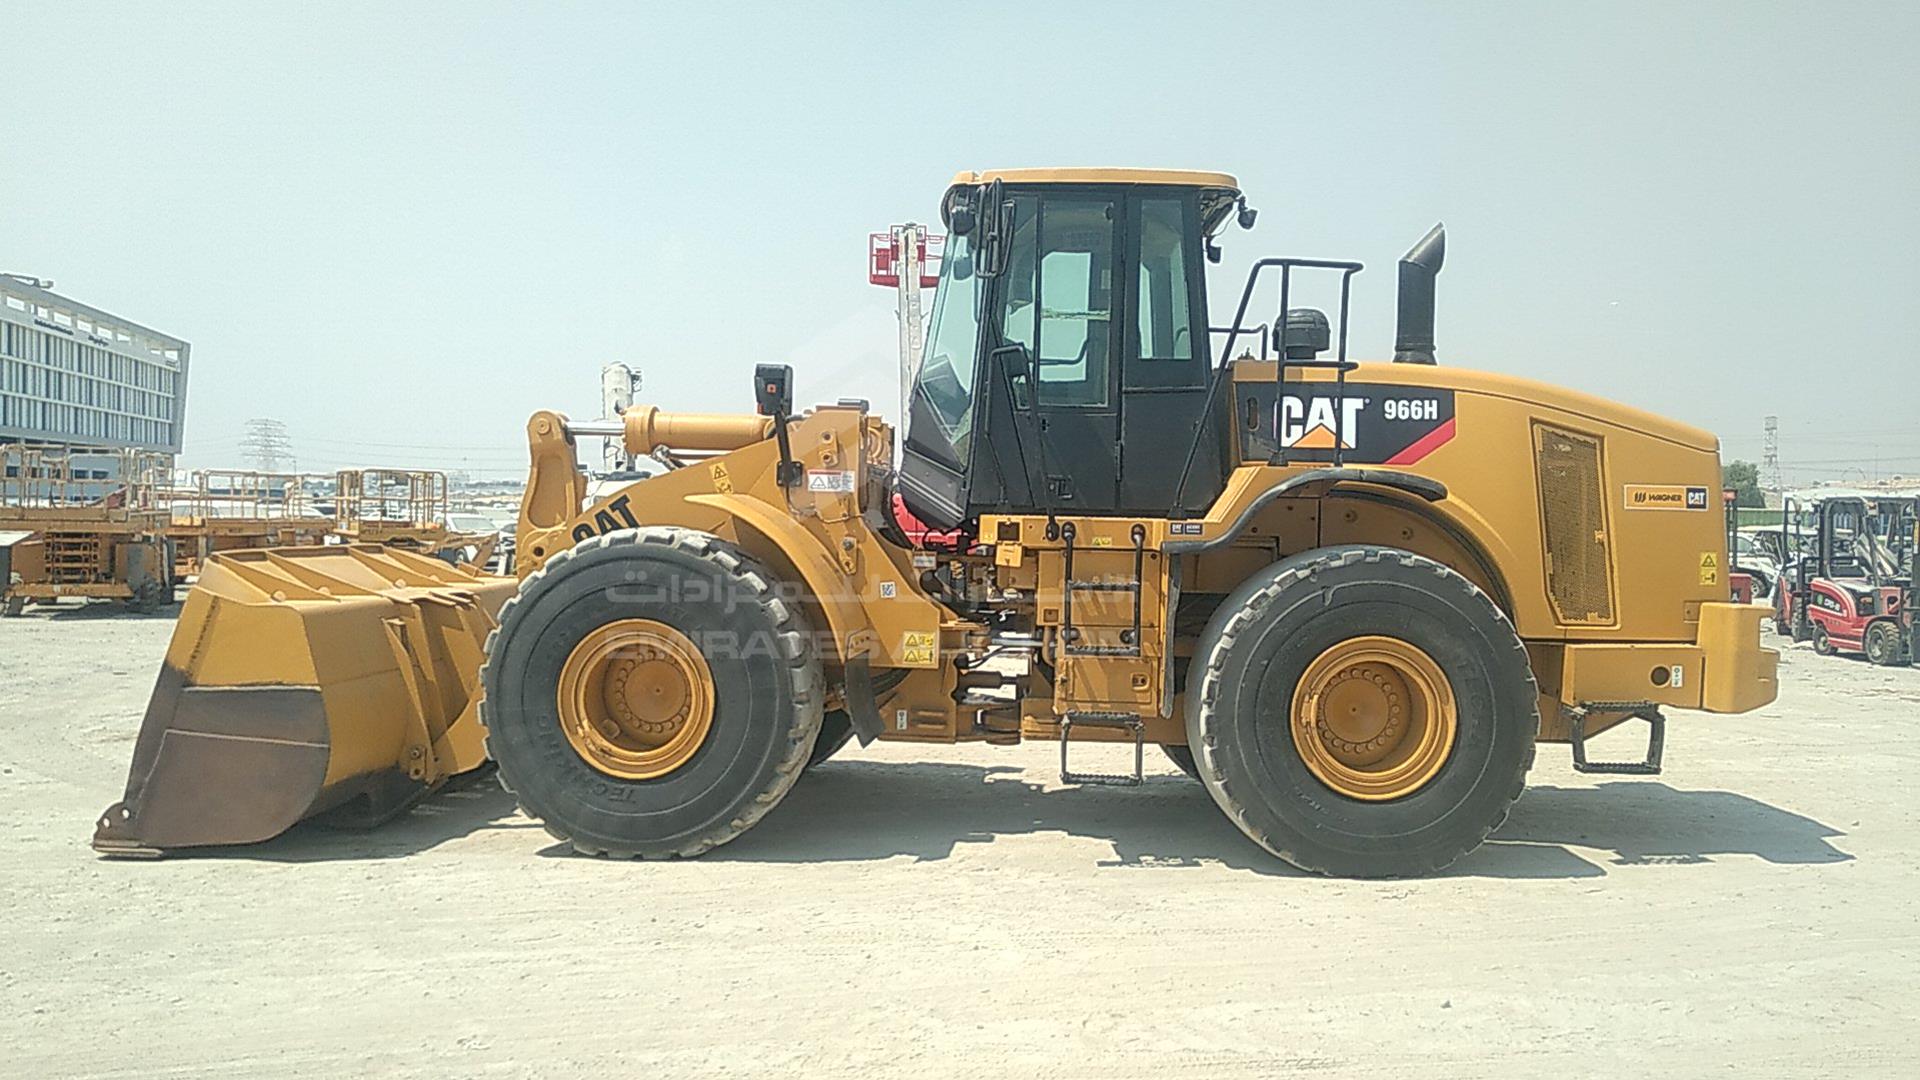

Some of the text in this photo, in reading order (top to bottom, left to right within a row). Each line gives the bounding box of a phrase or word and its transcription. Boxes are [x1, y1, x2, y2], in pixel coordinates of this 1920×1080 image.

[1274, 396, 1437, 449] CAT 966H
[1687, 492, 1705, 505] CAT
